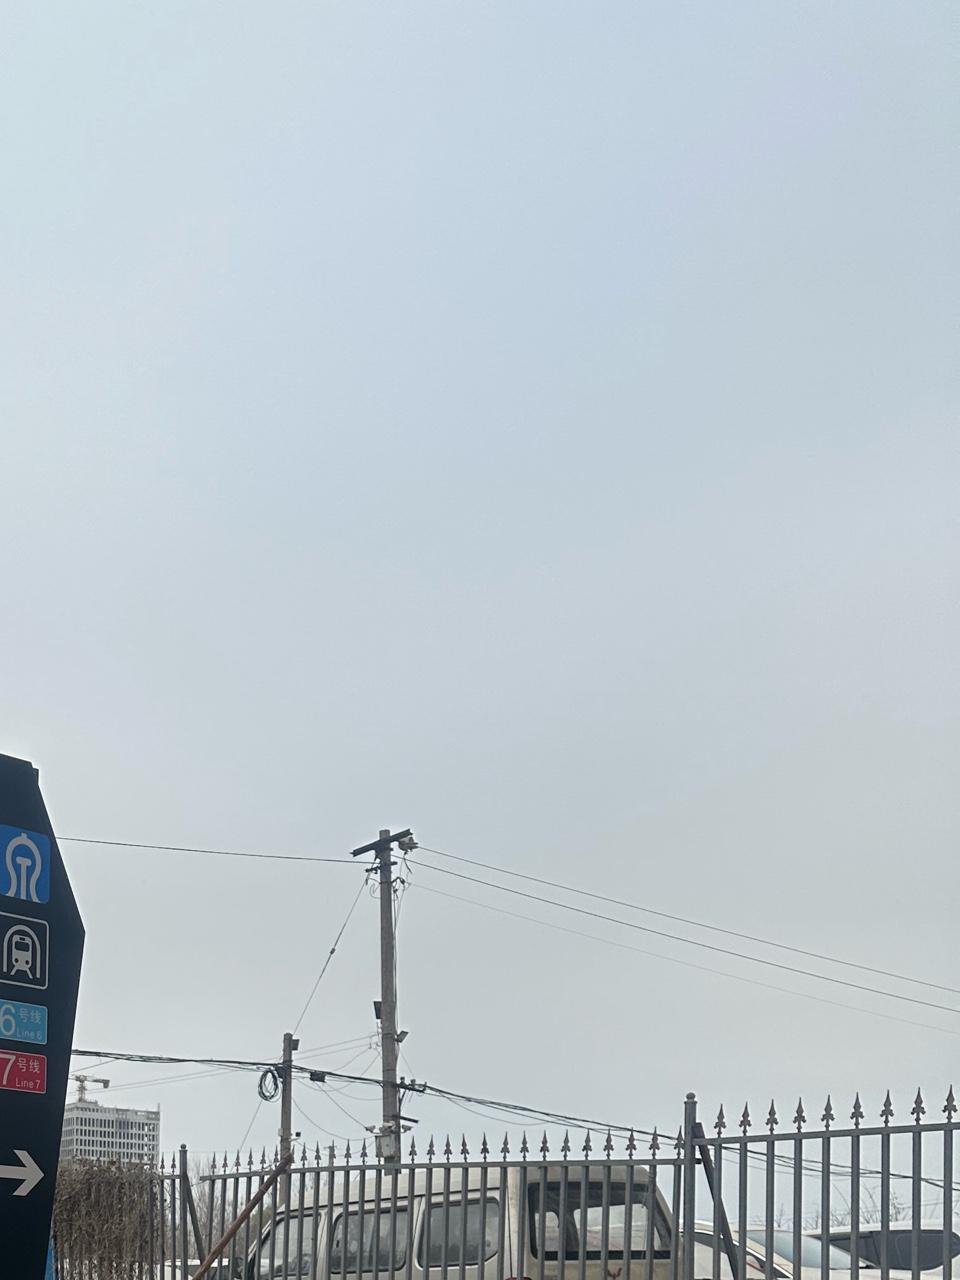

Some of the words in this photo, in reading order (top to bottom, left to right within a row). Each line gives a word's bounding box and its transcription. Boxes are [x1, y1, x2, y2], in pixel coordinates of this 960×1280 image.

[16, 1028, 35, 1039] Line
[37, 1031, 42, 1040] 6
[15, 1077, 34, 1088] Line
[36, 1080, 41, 1089] 7
